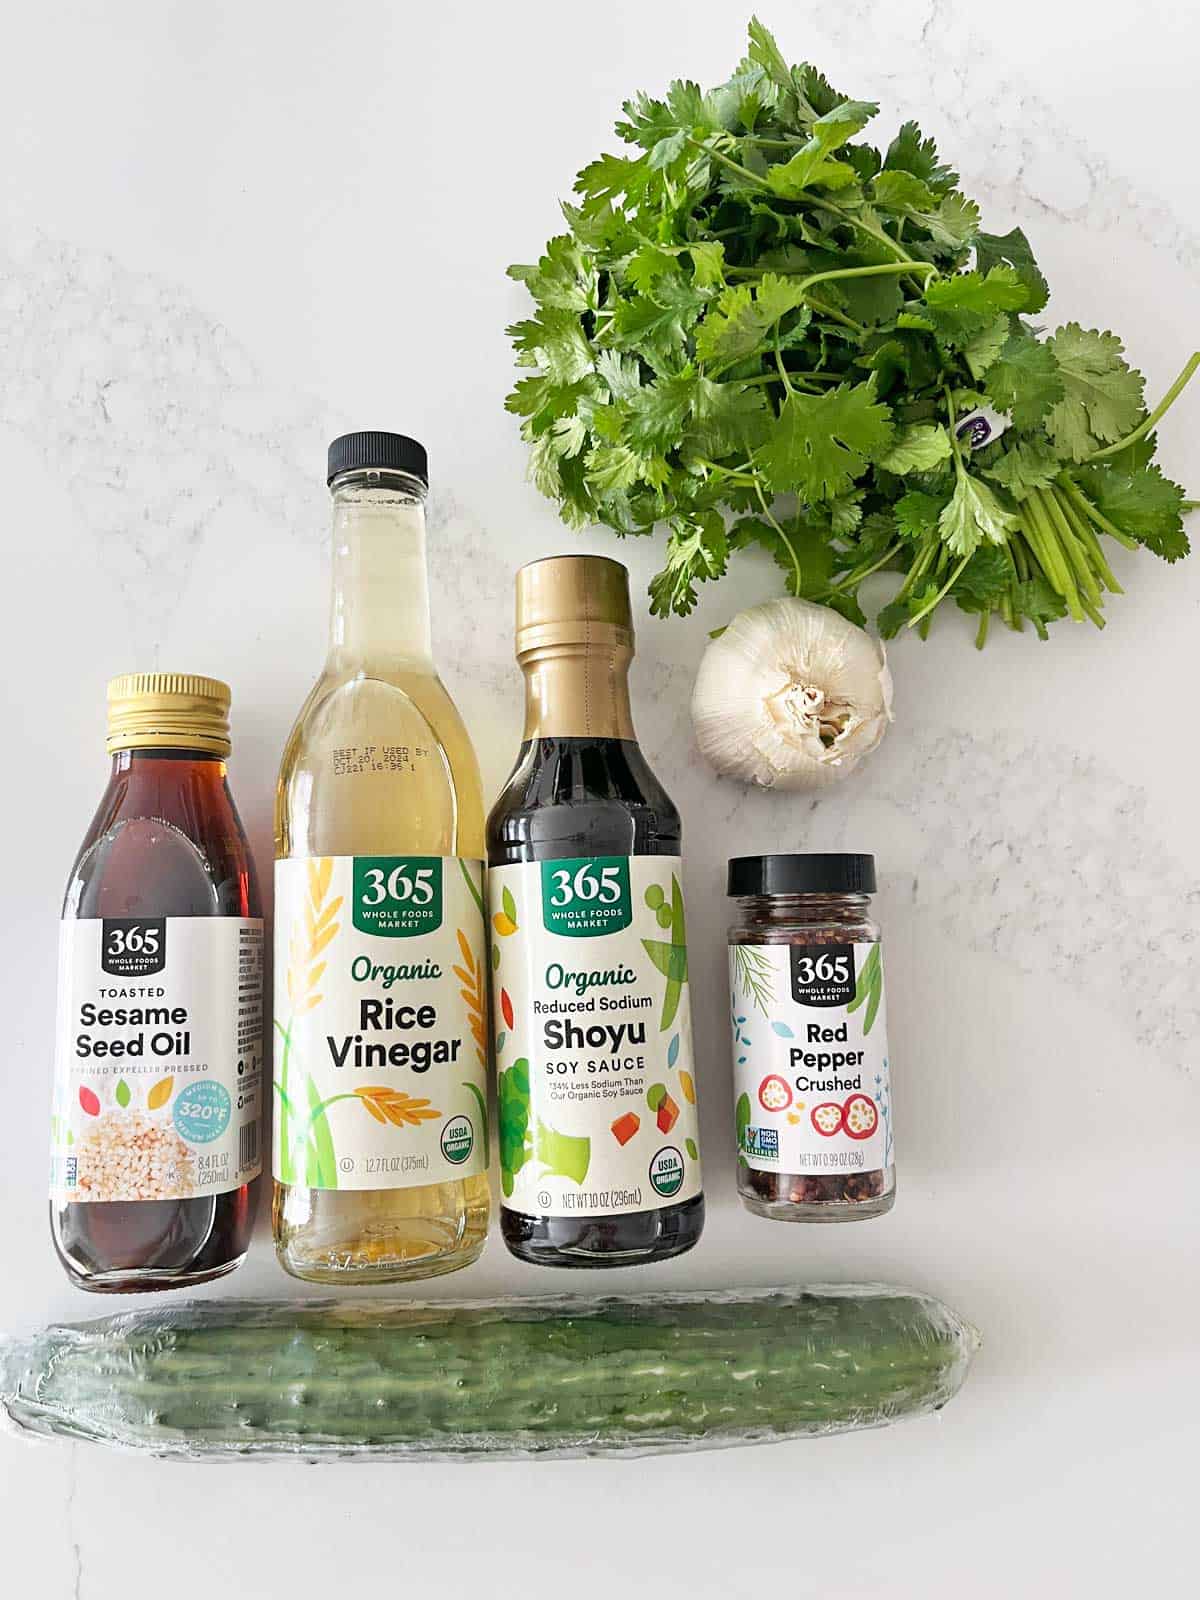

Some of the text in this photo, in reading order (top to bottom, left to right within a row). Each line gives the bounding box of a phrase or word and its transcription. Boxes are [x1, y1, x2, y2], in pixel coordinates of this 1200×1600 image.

[333, 746, 429, 759] BEST IF USED BY
[362, 864, 434, 905] 365
[550, 864, 622, 907] 365
[362, 910, 434, 919] WHOLE FOODS
[551, 908, 624, 920] WHOLE FOODS
[378, 920, 420, 929] MARKET
[567, 920, 609, 929] MARKET
[108, 926, 160, 955] 365
[351, 955, 443, 990] Organic
[797, 953, 849, 985] 365
[545, 963, 638, 997] Organic
[99, 987, 166, 998] TOASTED
[533, 995, 653, 1014] Reduced Sodium
[80, 1003, 188, 1026] Sesame
[360, 997, 437, 1031] Rice
[543, 1018, 646, 1054] Shoyu
[806, 1022, 848, 1043] Red
[76, 1032, 191, 1058] Seed Oil
[326, 1035, 462, 1074] Vinegar
[789, 1048, 865, 1073] Pepper
[164, 1063, 209, 1073] PRESSED
[545, 1056, 645, 1074] SOY SAUCE
[571, 1080, 589, 1090] Less
[591, 1079, 622, 1089] Sodium
[624, 1077, 644, 1086] Than
[795, 1074, 862, 1092] Crushed
[550, 1086, 644, 1101] Our Organic Soy Sauce
[449, 1126, 468, 1139] USDA
[658, 1158, 678, 1171] USDA
[562, 1194, 576, 1208] NET
[577, 1193, 588, 1207] WT
[589, 1193, 598, 1207] 10
[599, 1192, 610, 1207] OZ
